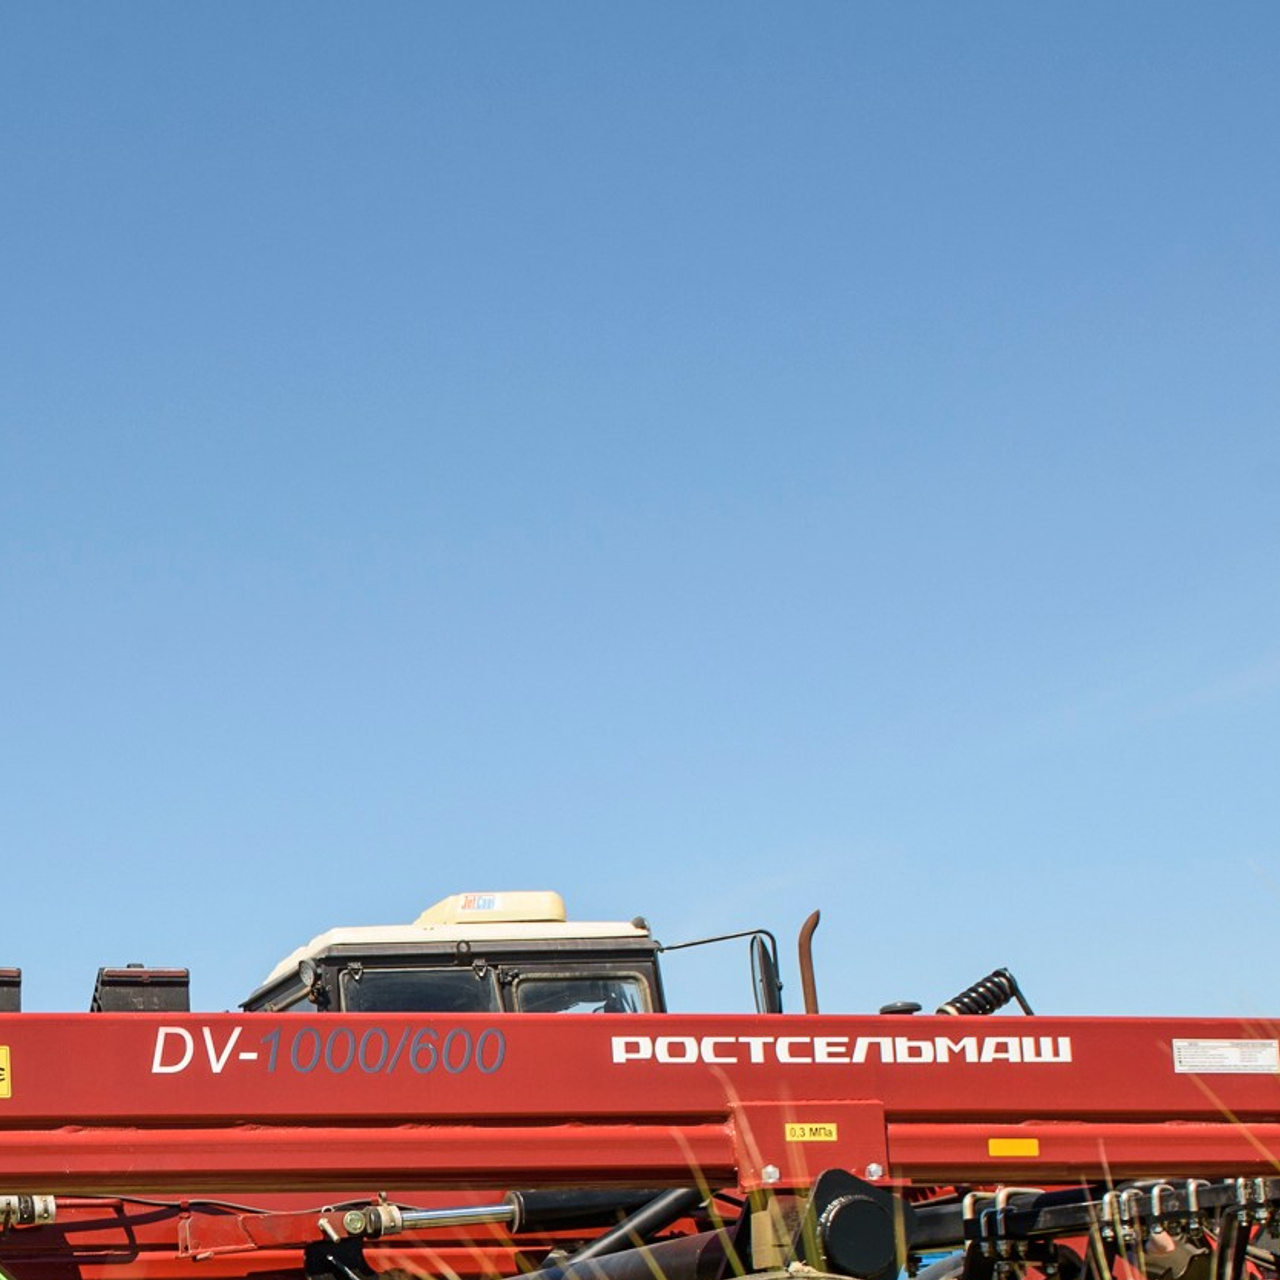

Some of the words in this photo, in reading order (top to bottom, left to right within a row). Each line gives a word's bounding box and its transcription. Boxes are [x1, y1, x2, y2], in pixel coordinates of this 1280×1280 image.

[151, 1026, 506, 1074] DV-1000/600
[611, 1036, 1072, 1063] РОСТСЕЛЬМАШ
[789, 1127, 806, 1138] 0,3
[809, 1127, 833, 1138] МПа
